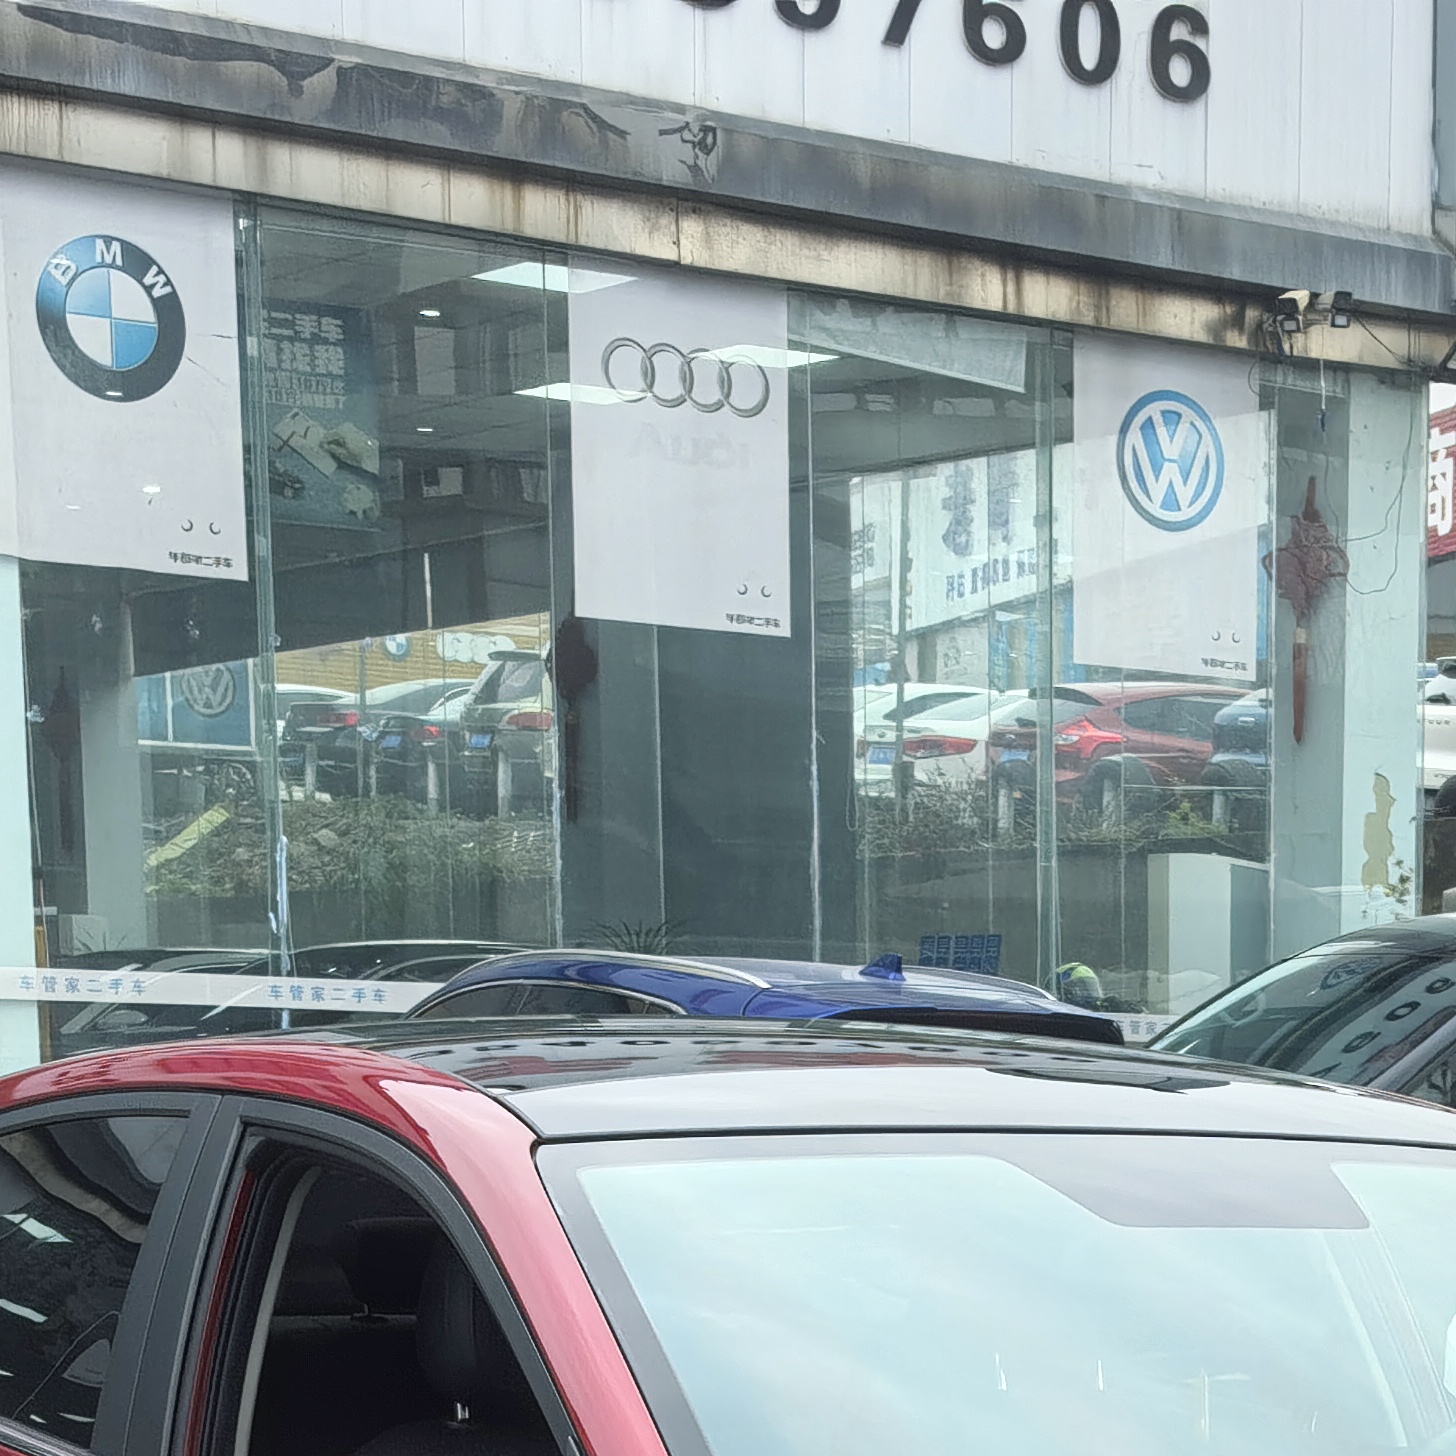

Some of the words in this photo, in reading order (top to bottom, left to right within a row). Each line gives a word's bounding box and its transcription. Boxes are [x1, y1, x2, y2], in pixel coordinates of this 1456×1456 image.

[19, 974, 147, 997] 车管家二手车
[268, 983, 388, 1005] 车管家二手车
